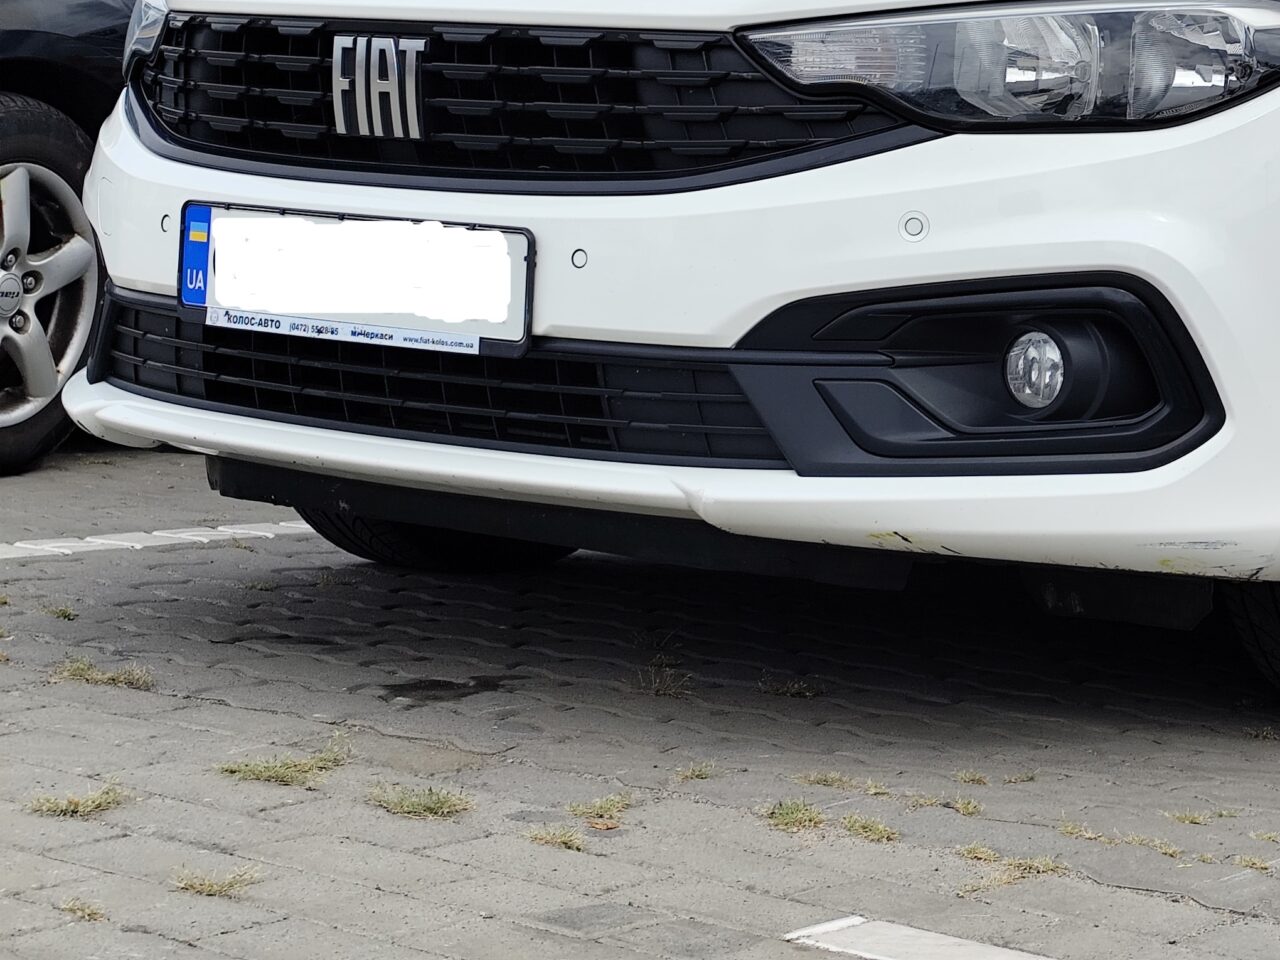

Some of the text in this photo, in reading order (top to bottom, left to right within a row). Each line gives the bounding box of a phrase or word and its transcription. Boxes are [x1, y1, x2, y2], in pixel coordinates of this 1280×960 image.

[331, 34, 428, 140] FIAT
[186, 268, 205, 291] UA
[226, 314, 281, 329] КОЛОС-АВТО
